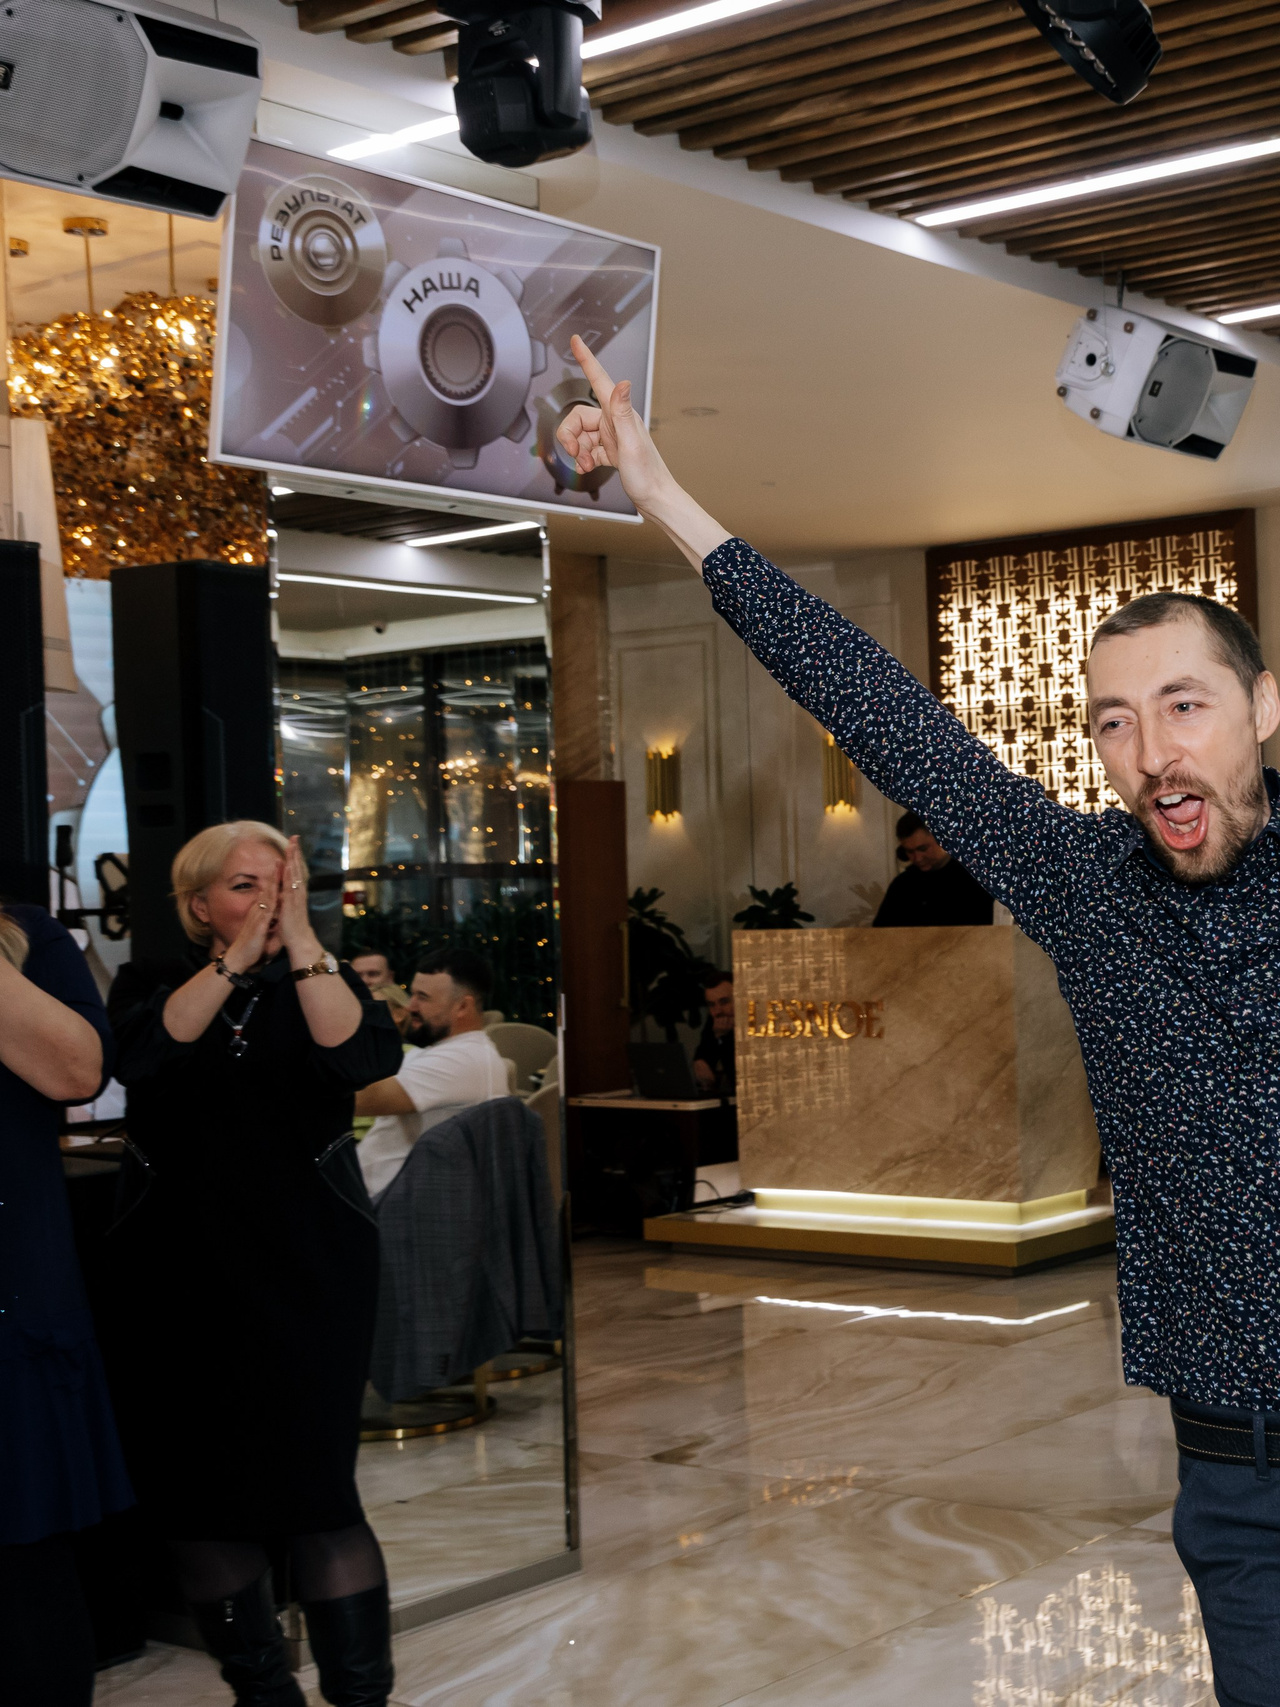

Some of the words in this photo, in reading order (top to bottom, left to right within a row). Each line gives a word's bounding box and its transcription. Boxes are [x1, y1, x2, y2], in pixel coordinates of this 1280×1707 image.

[270, 189, 366, 261] РЕЗУЛЬТАТ
[402, 272, 480, 313] НАША
[747, 1000, 884, 1039] LESNOE
